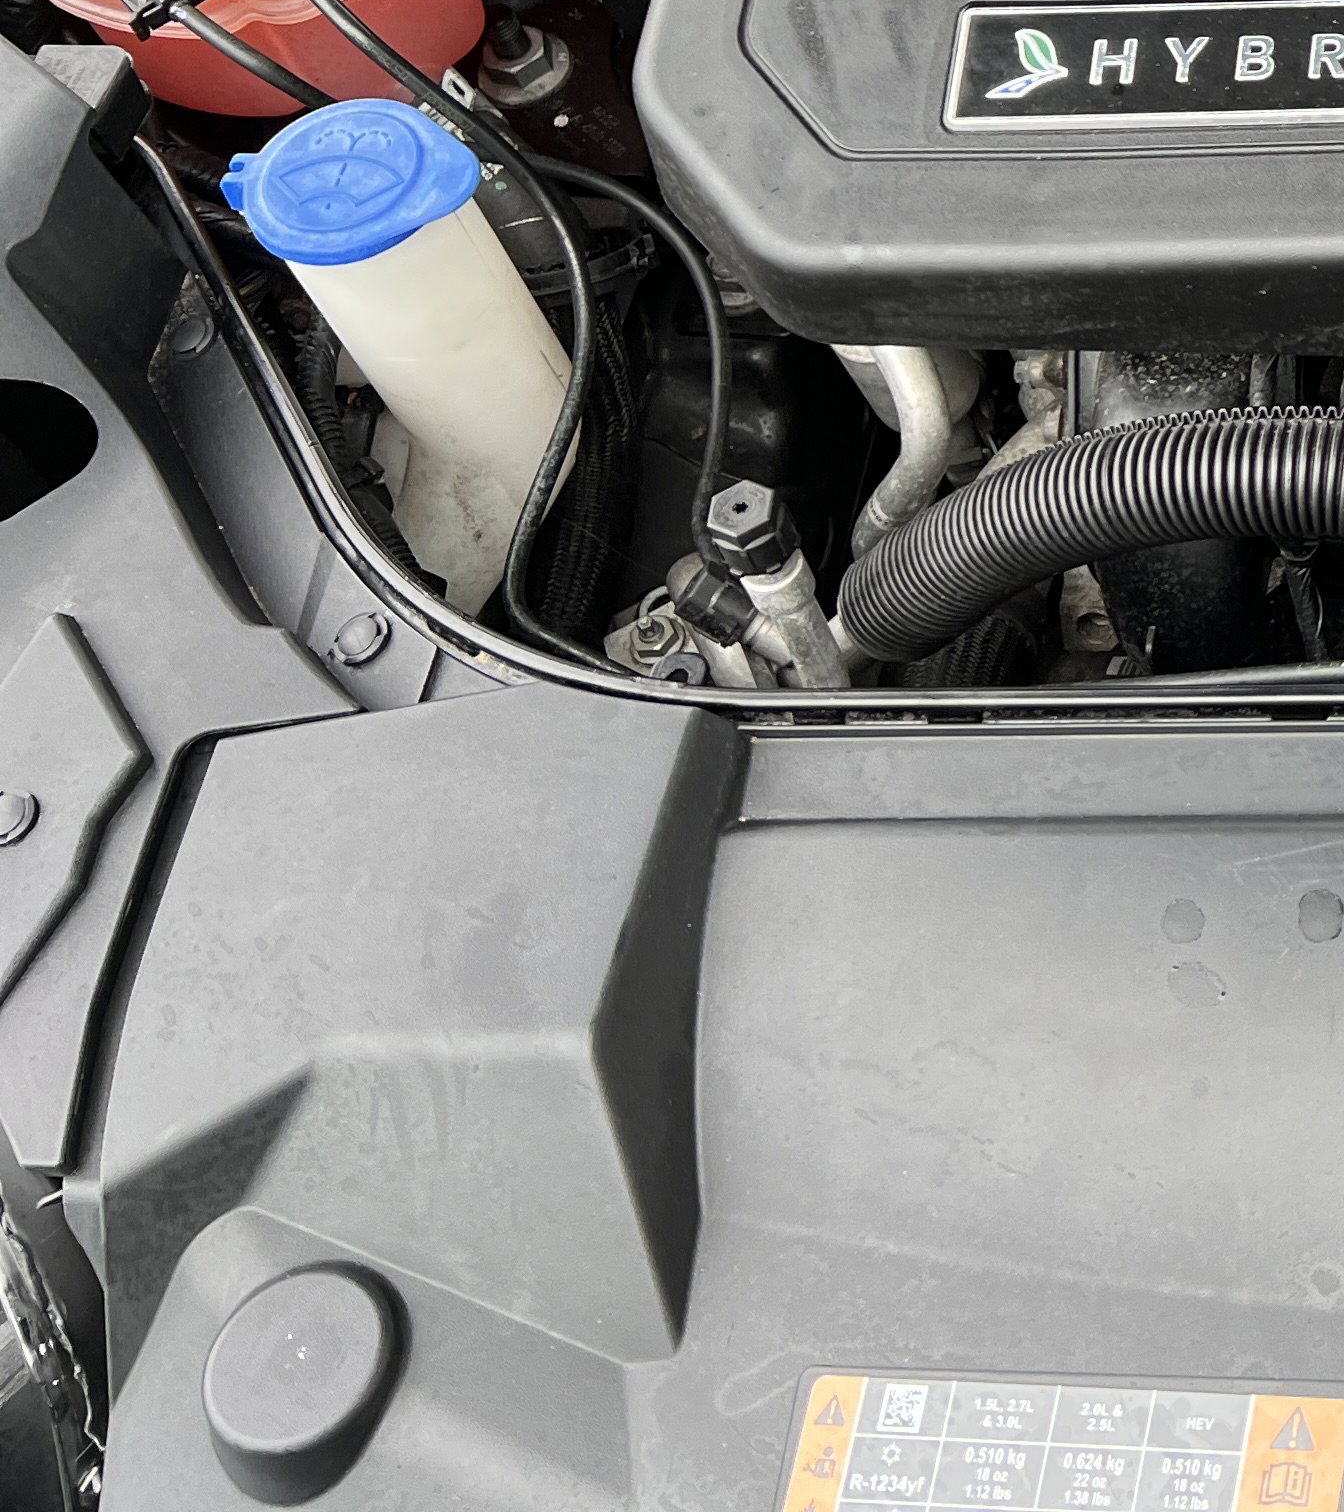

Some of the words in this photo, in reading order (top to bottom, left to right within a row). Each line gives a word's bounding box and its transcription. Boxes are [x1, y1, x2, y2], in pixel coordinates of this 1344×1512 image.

[1007, 1399, 1034, 1413] 2.7L
[1080, 1402, 1109, 1416] 2.0L
[1112, 1403, 1123, 1416] &
[983, 1415, 992, 1428] &
[996, 1415, 1023, 1429] 3.0L
[1086, 1418, 1115, 1432] 2.5L
[1185, 1417, 1215, 1431] HEV
[964, 1446, 1004, 1465] 0.510
[1007, 1451, 1026, 1470] kg
[1063, 1452, 1103, 1471] 0.624
[1105, 1456, 1125, 1475] kg
[976, 1467, 991, 1481] 18
[992, 1471, 1008, 1482] oz
[1161, 1457, 1201, 1476] 0.510
[1203, 1460, 1222, 1478] kg
[849, 1474, 925, 1495] R-1234yf
[1073, 1473, 1089, 1487] 22
[1091, 1476, 1107, 1488] oz
[1173, 1478, 1188, 1492] 18
[1189, 1482, 1205, 1494] oz
[964, 1484, 990, 1500] 1.12
[993, 1485, 1012, 1501] lbs
[1064, 1490, 1089, 1505] 1.38
[1090, 1491, 1111, 1506] lbs
[1163, 1494, 1188, 1510] 1.12
[1190, 1496, 1209, 1511] lbs
